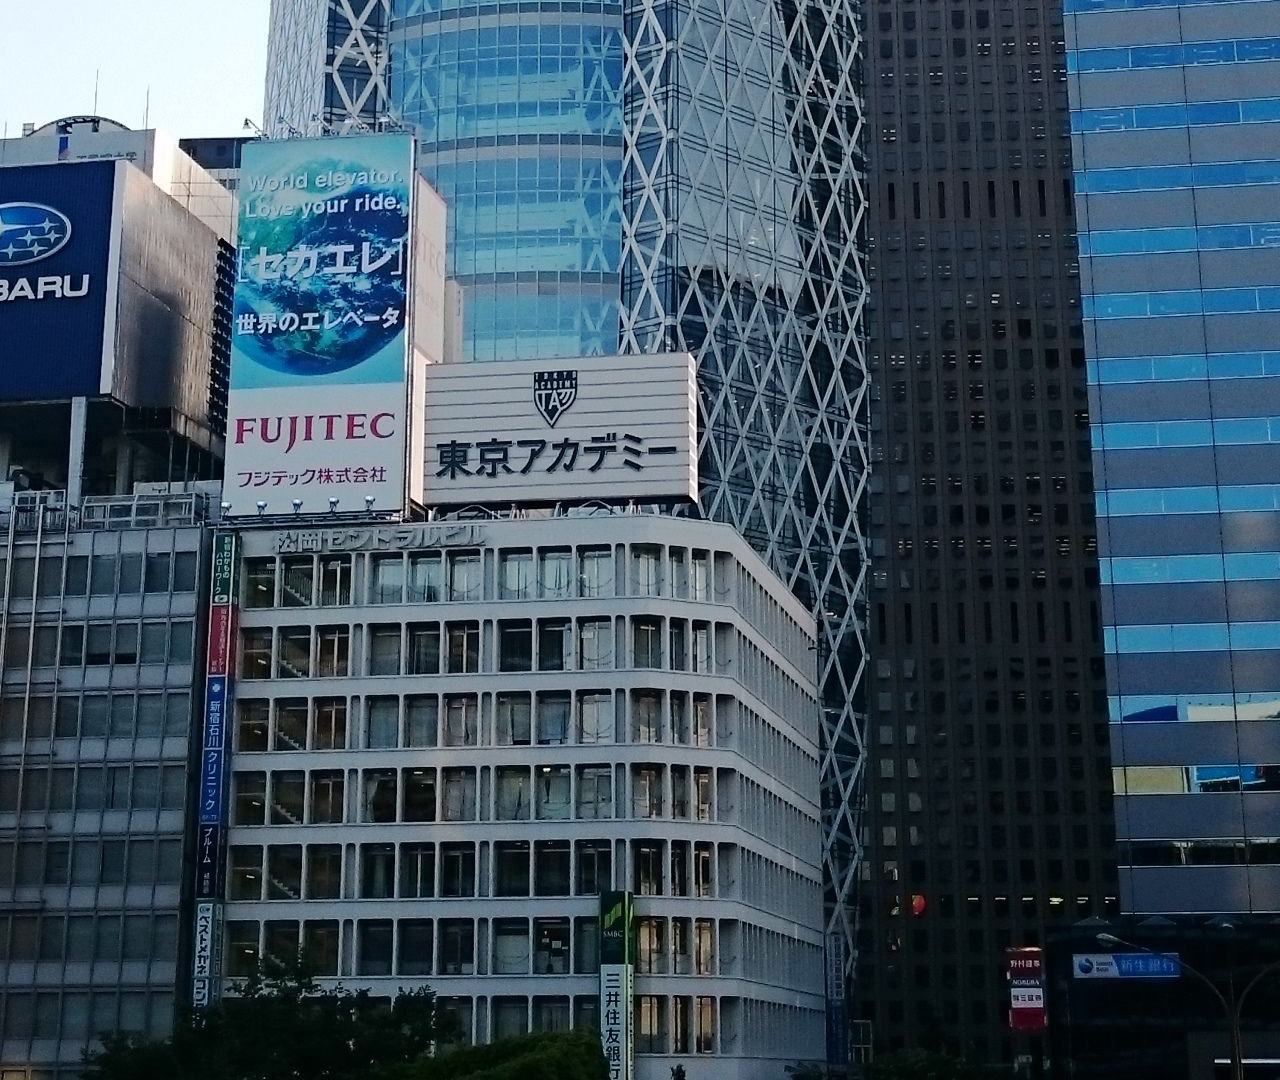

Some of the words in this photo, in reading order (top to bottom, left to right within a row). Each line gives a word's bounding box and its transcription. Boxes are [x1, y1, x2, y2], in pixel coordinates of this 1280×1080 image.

[249, 172, 308, 192] World
[314, 168, 404, 189] elevator.
[244, 201, 297, 218] Love
[301, 198, 349, 219] your
[354, 193, 402, 212] ride.
[235, 306, 401, 336] 世界のエレベータ
[534, 370, 577, 381] TOKYO
[534, 379, 577, 390] ACADEMY
[234, 412, 396, 454] FUJITEC
[435, 432, 677, 481] 東京アカデミー
[237, 466, 387, 488] フジテック株式会社
[603, 930, 624, 938] SMBC
